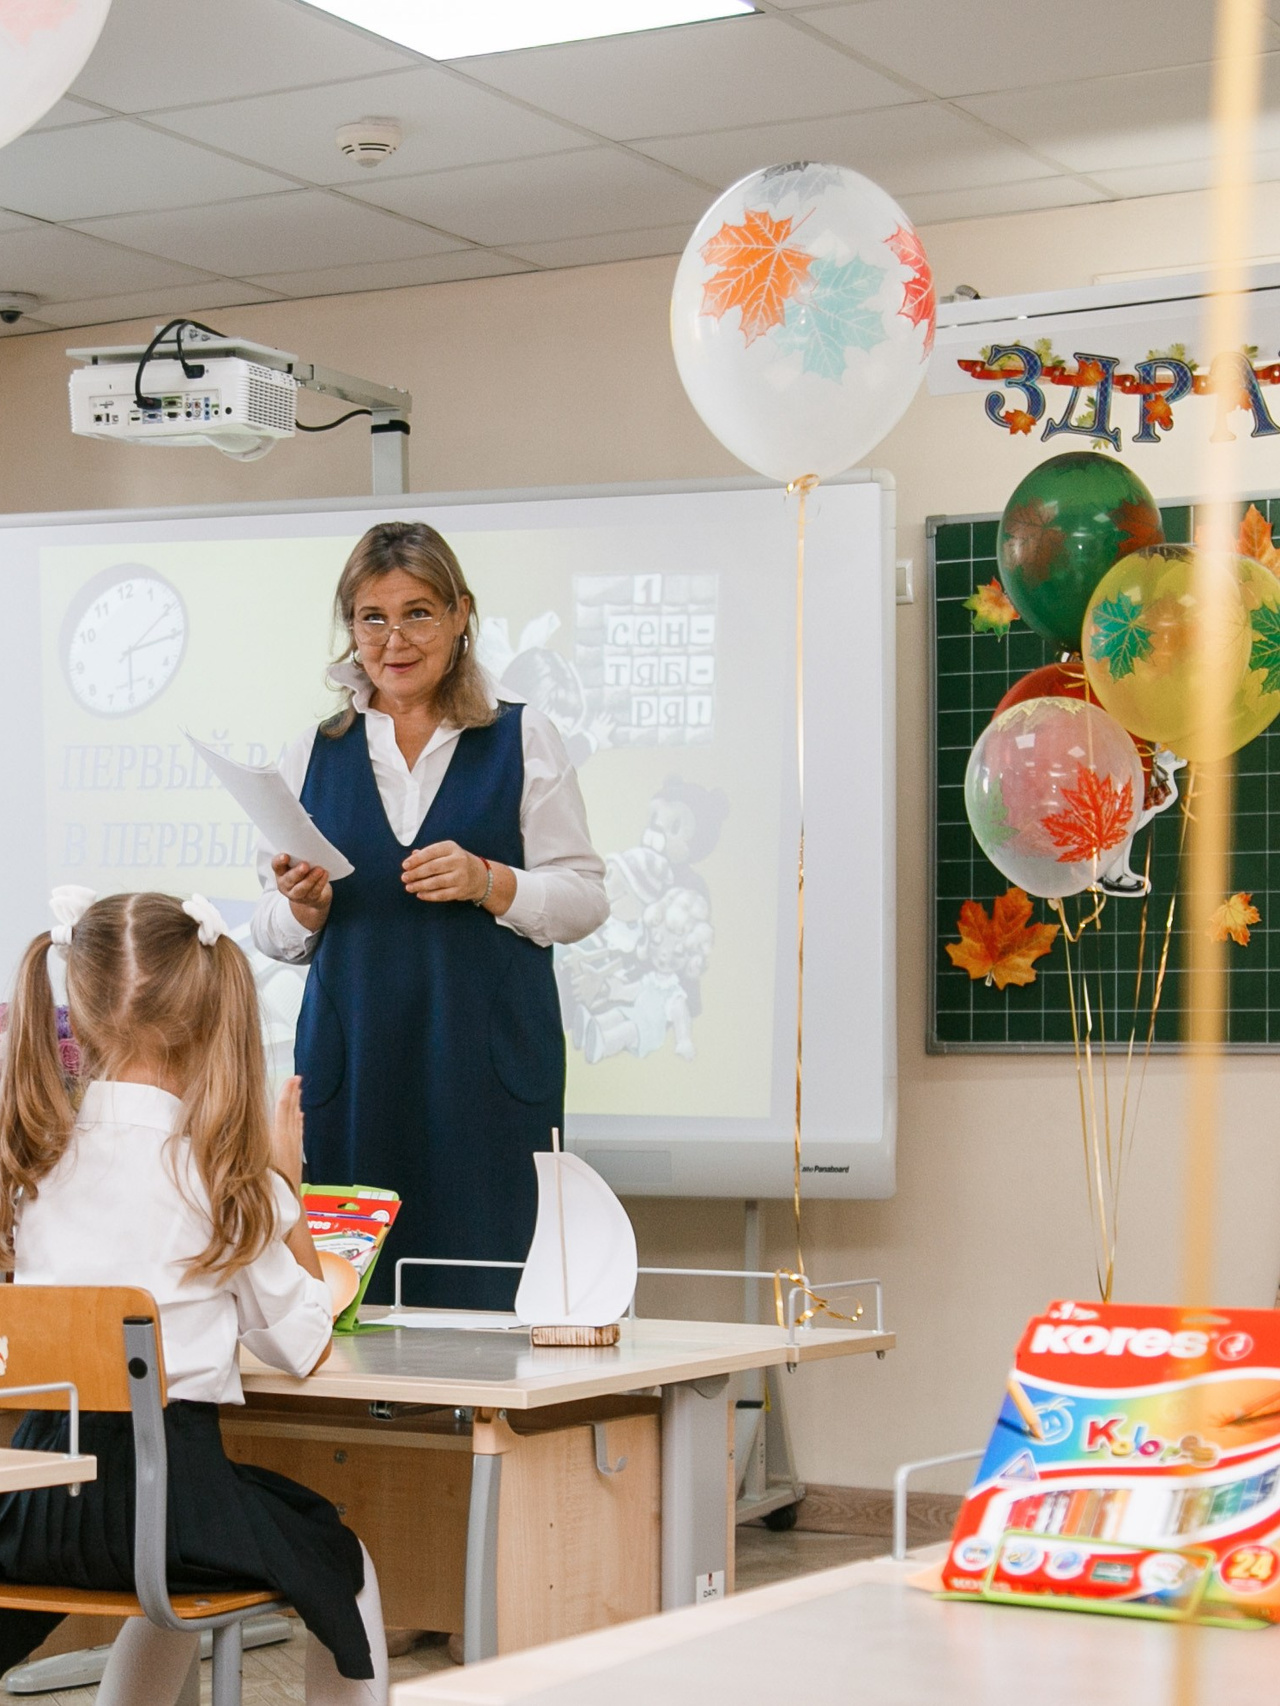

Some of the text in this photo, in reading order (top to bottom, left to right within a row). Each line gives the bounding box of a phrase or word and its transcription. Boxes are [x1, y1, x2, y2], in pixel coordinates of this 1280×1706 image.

[117, 583, 133, 600] 12
[147, 587, 154, 601] 1
[641, 578, 654, 605] 1
[94, 602, 109, 618] 11
[79, 628, 96, 644] 10
[76, 661, 85, 675] 9
[61, 822, 89, 868] В
[1230, 1551, 1274, 1581] 24
